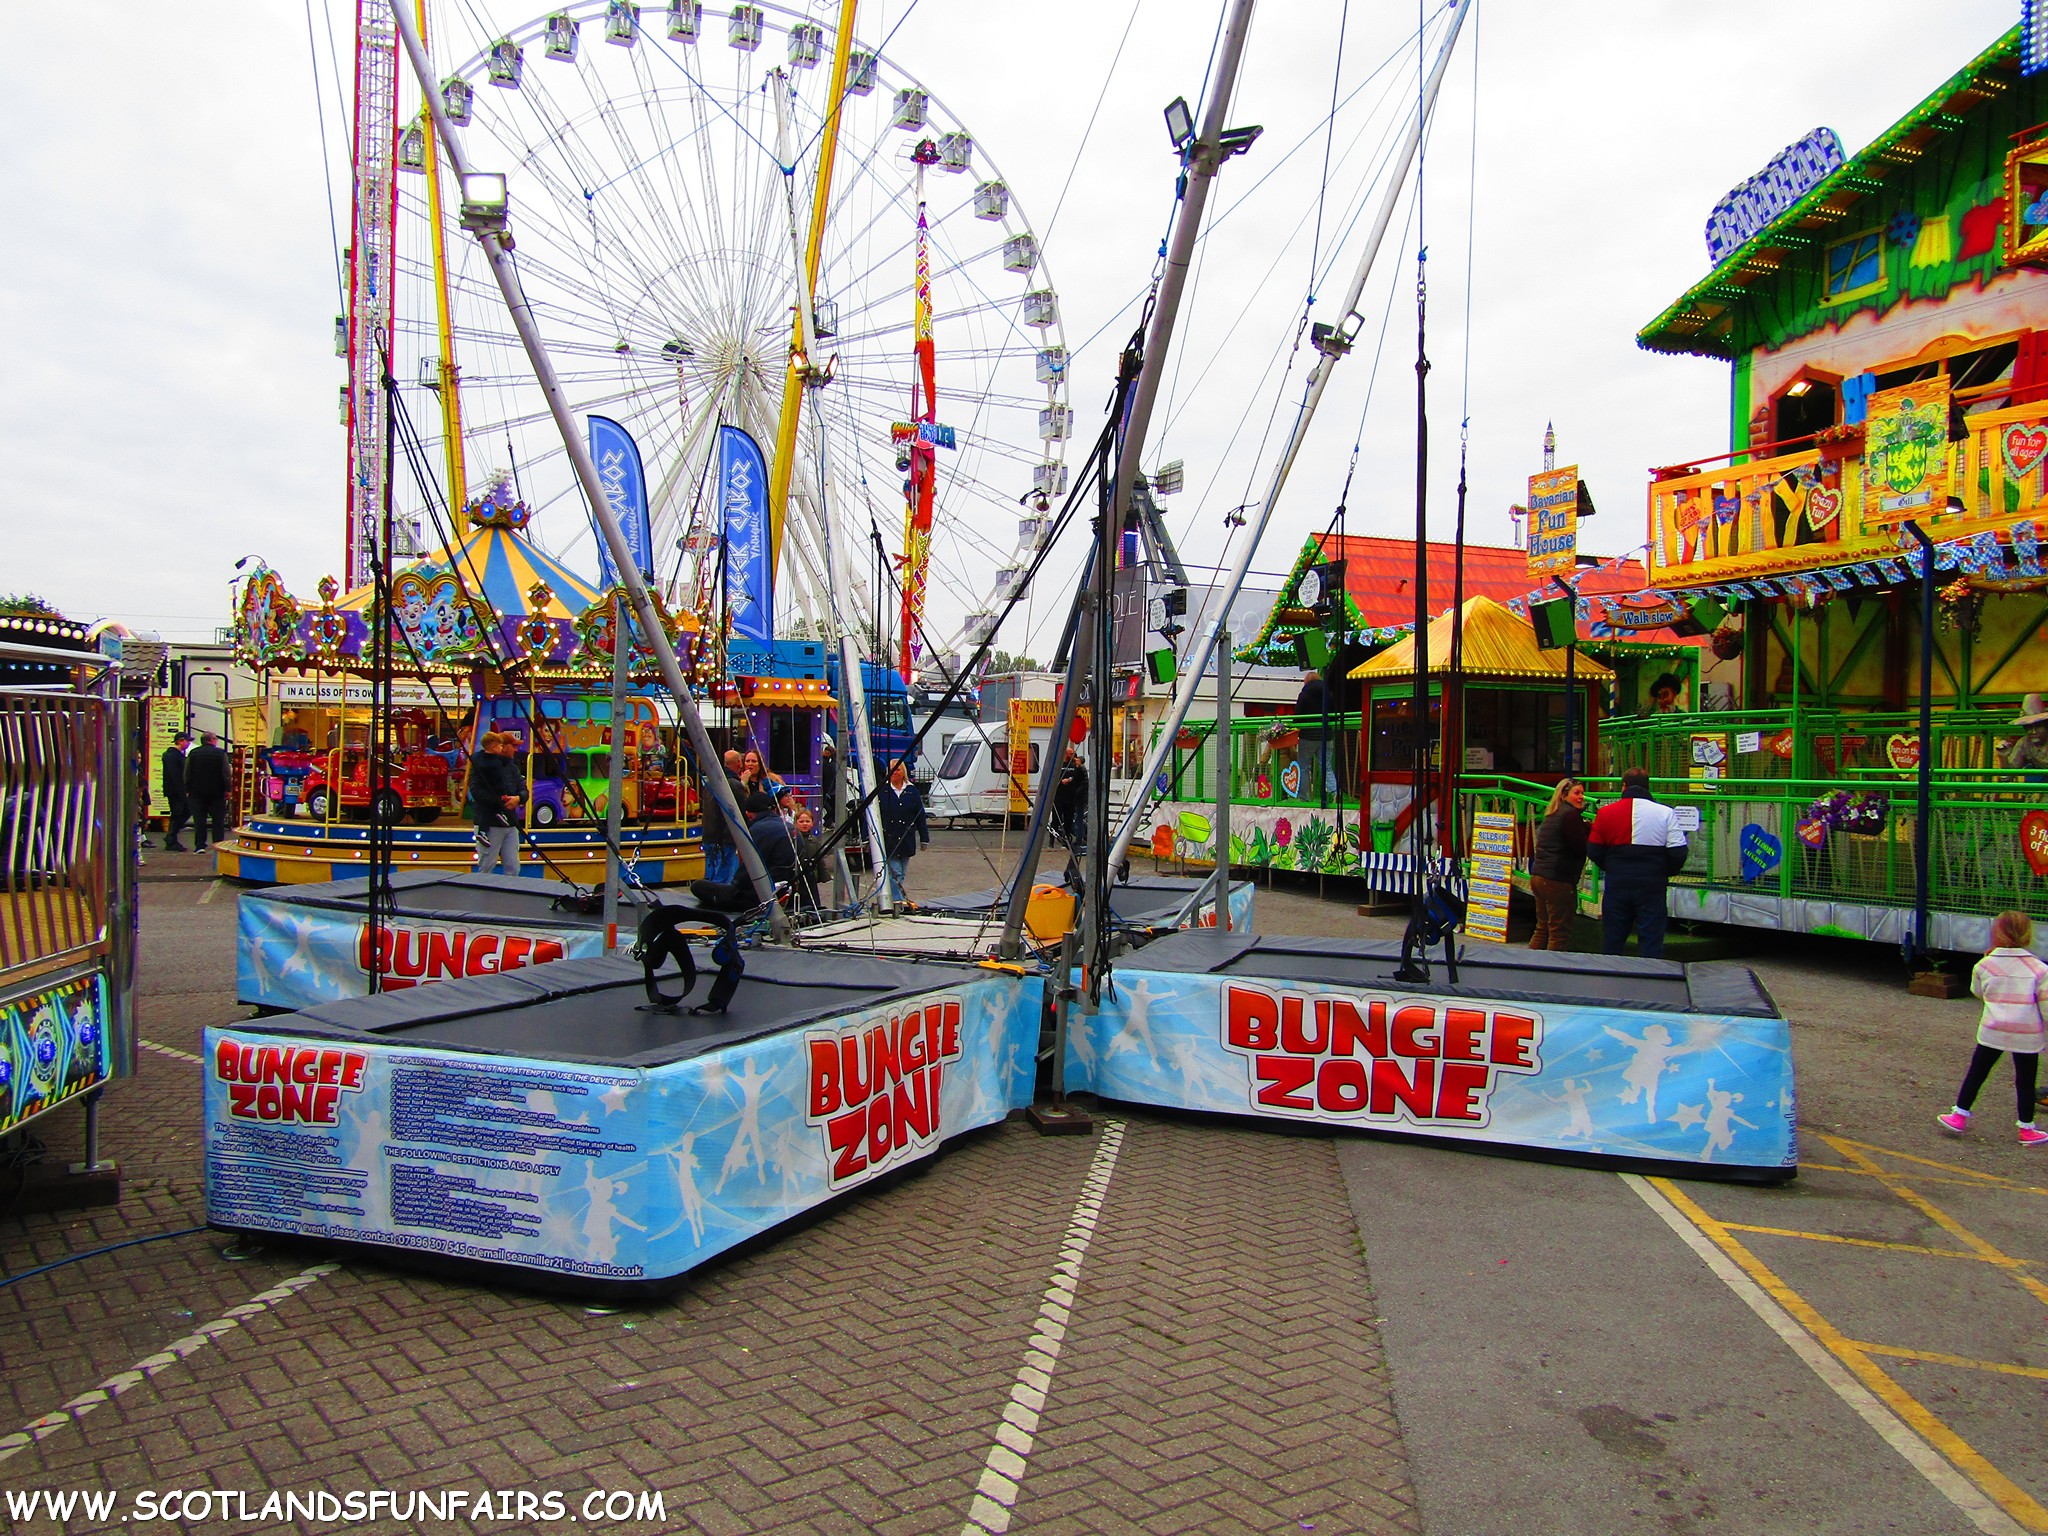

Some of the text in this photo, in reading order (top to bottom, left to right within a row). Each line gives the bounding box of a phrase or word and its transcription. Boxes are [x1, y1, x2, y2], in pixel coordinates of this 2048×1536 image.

[1713, 131, 1833, 254] BAVARIAN
[2028, 434, 2042, 445] for
[2021, 449, 2038, 460] ages
[1531, 490, 1575, 510] Bavarian
[1812, 493, 1832, 510] Crazy
[1537, 509, 1566, 533] Fun
[1529, 533, 1574, 557] House
[1622, 610, 1673, 625] Walk slow
[306, 688, 331, 696] CLASS
[333, 688, 342, 696] OF
[561, 723, 608, 749] TOY
[1896, 754, 1914, 763] inside
[2030, 825, 2037, 835] 3
[2030, 841, 2043, 851] of
[1229, 986, 1534, 1068] BUNGEE
[217, 1040, 366, 1088] BUNGEE
[810, 1002, 960, 1118] BUNGEE
[402, 1057, 444, 1068] FOLLOWING
[445, 1062, 476, 1071] PERSONS
[478, 1065, 497, 1073] MUST
[514, 1068, 546, 1078] ATTEMPT
[589, 1075, 618, 1084] DEVICE
[618, 1078, 637, 1086] WHO
[1256, 1054, 1489, 1120] ZONE
[230, 1083, 338, 1122] ZONE
[224, 1134, 262, 1146] demanding
[277, 1141, 302, 1151] activity
[229, 1126, 254, 1136] Bungee
[254, 1128, 290, 1140] Trampoline
[303, 1134, 338, 1146] physically
[213, 1142, 235, 1151] Please
[236, 1145, 252, 1153] read
[266, 1148, 295, 1159] following
[296, 1152, 316, 1162] safety
[317, 1154, 341, 1163] notice
[385, 1148, 560, 1174] THE FOLLOWING RESTRICTIONS ALSO APPLY
[241, 1215, 250, 1225] to
[252, 1216, 269, 1227] hire
[270, 1219, 284, 1229] for
[286, 1222, 301, 1232] any
[303, 1223, 328, 1236] event,
[330, 1227, 358, 1240] please
[360, 1231, 394, 1244] contact
[430, 1240, 447, 1251] 307
[448, 1242, 466, 1253] 545
[467, 1246, 477, 1255] or
[478, 1246, 504, 1259] email
